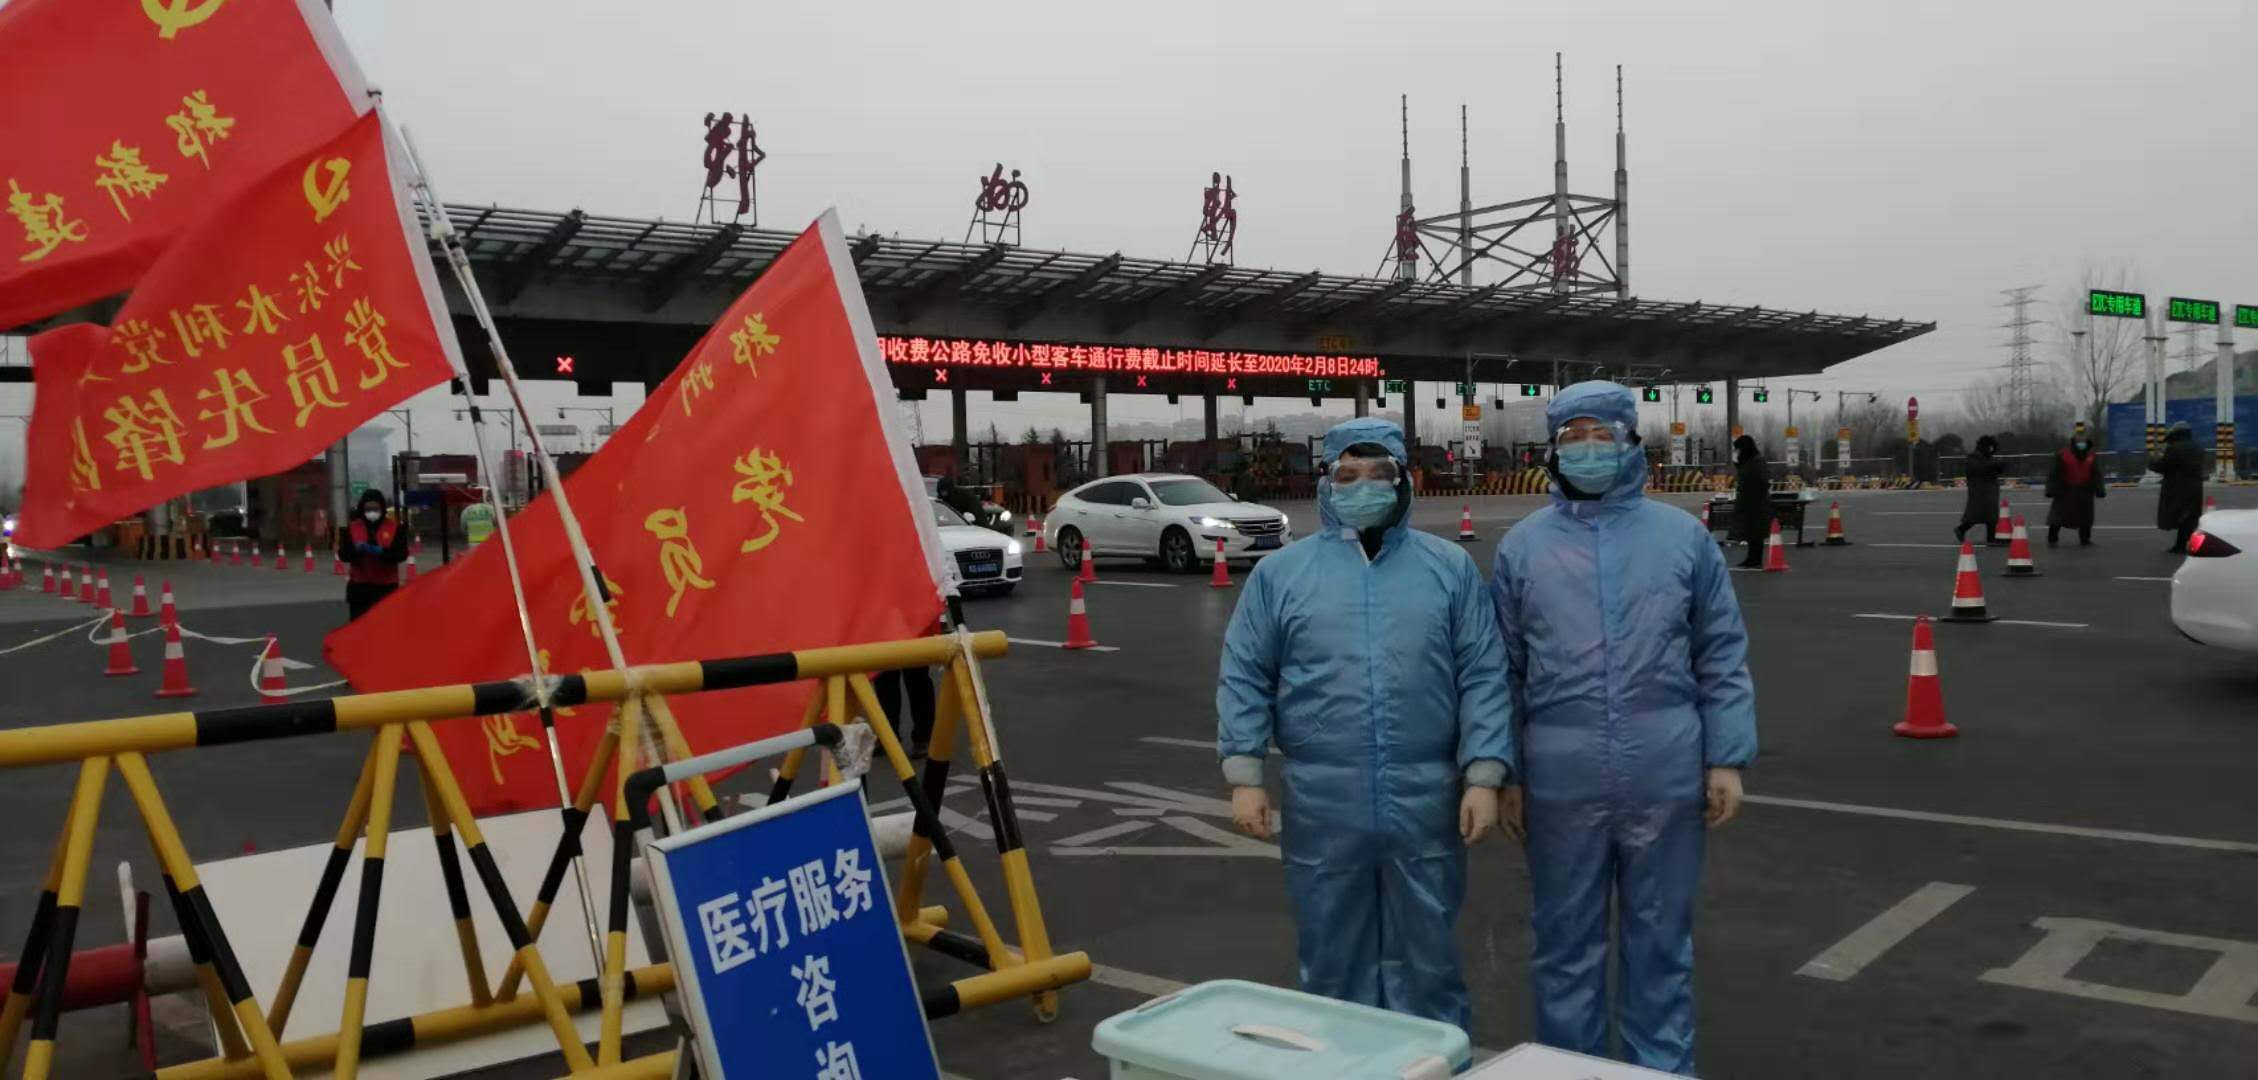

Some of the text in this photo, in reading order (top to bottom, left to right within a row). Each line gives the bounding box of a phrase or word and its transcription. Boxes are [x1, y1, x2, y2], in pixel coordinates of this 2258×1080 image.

[1309, 379, 1331, 392] ETC
[698, 848, 872, 975] 医疗服务
